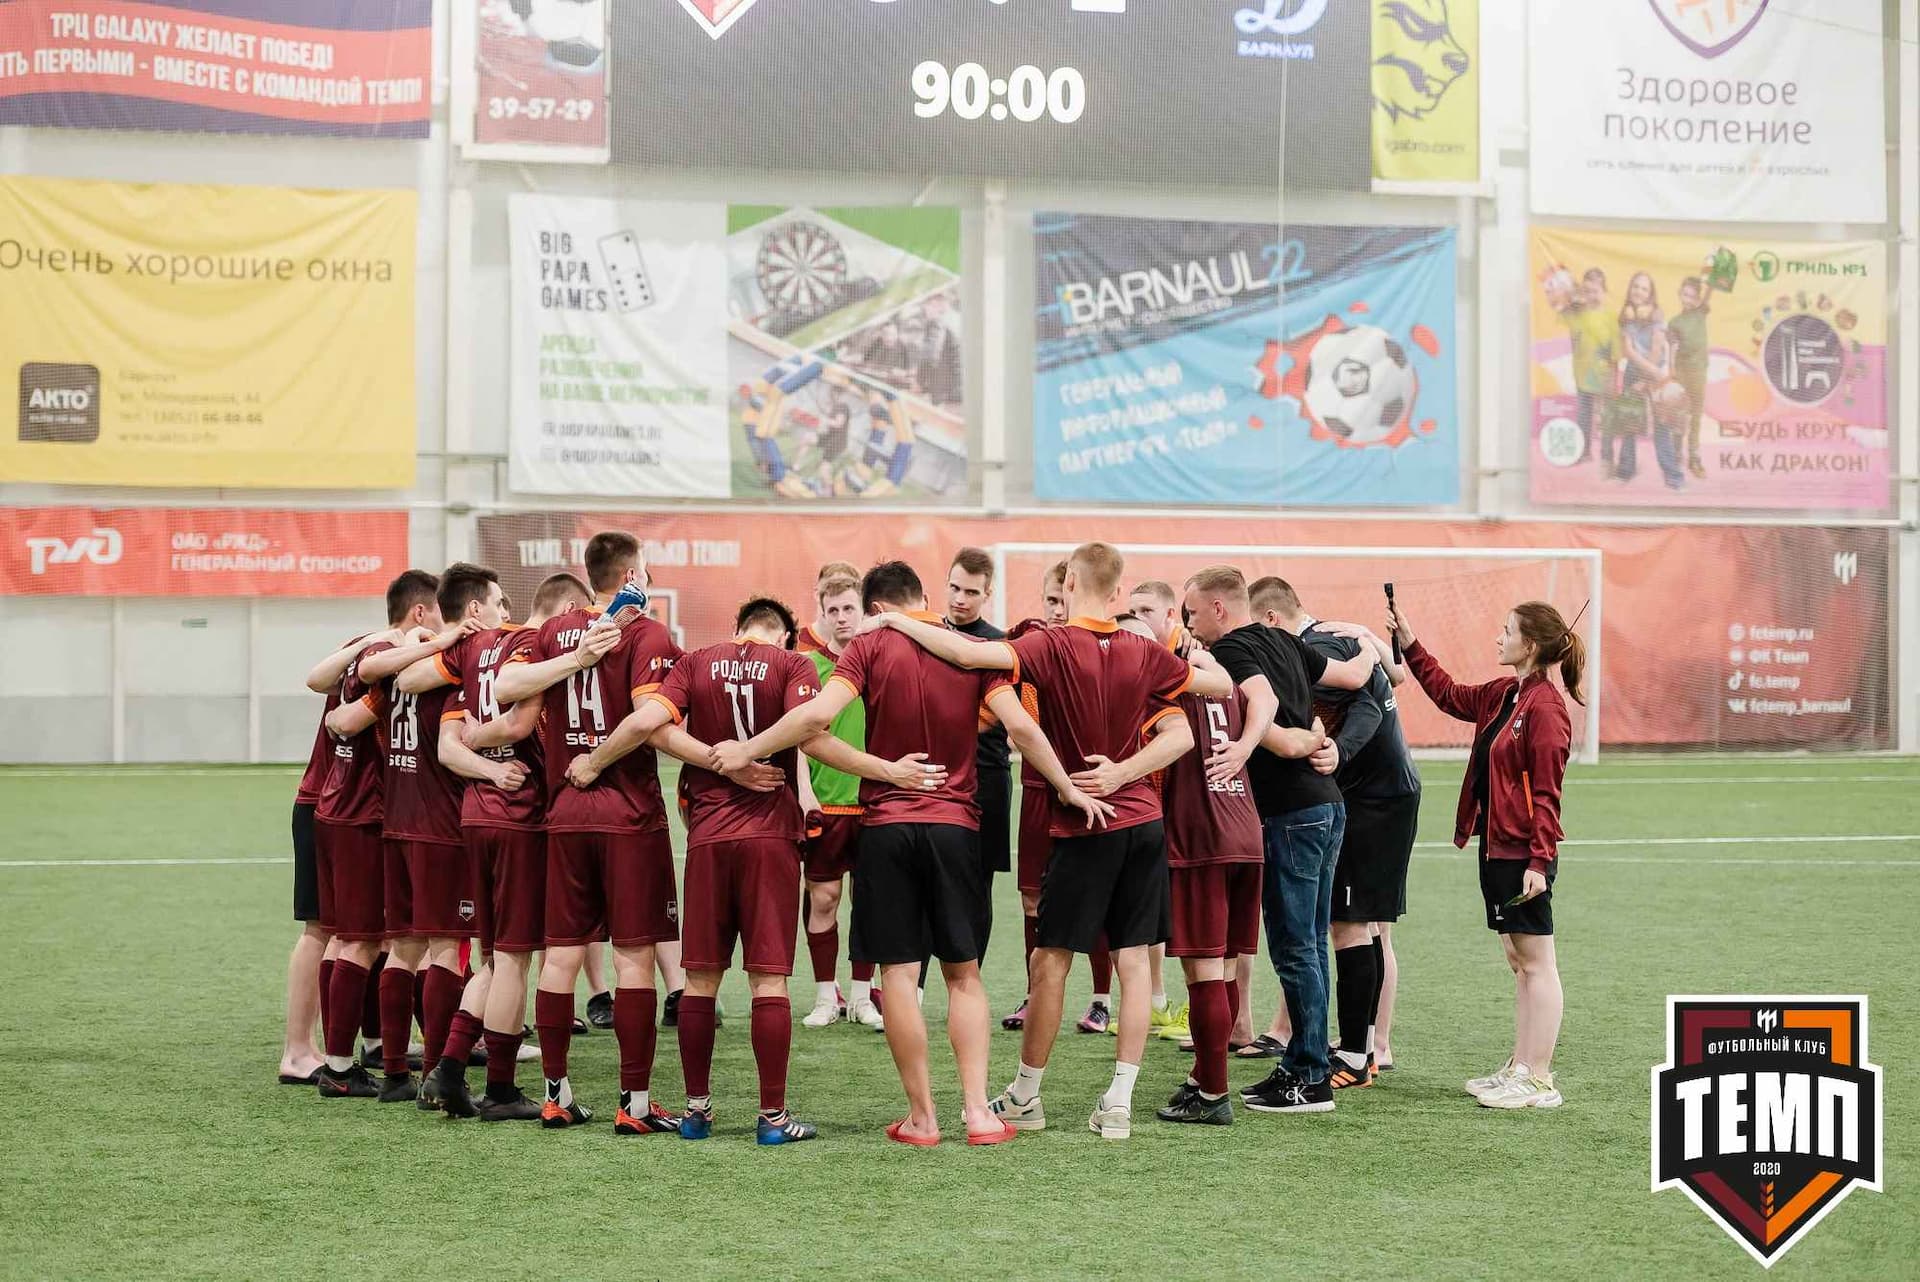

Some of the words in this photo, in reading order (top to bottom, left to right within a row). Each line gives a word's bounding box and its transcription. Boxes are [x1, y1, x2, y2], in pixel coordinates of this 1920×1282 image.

[50, 12, 89, 40] ТРЦ
[94, 14, 171, 45] GALAXY
[175, 26, 256, 60] ЖЕЛАЕТ
[261, 37, 333, 71] ПОБЕД!
[1237, 40, 1314, 60] БАРНАУЛ
[33, 47, 135, 77] ПЕРВЫМИ
[153, 55, 231, 92] ВМЕСТЕ
[235, 67, 249, 92] С
[253, 71, 361, 107] КОМАНДОЙ
[1616, 67, 1798, 107] Здоровое
[911, 60, 1086, 123] 90:00
[488, 97, 594, 120] 39-57-29
[1603, 113, 1812, 145] поколение
[540, 231, 572, 254] BIG
[0, 239, 113, 275] Очень
[127, 252, 294, 284] хорошие
[307, 259, 392, 283] окна
[541, 259, 591, 283] PAPA
[1786, 261, 1838, 276] ГРИЛЬ
[541, 286, 607, 311] GAMES
[1719, 453, 1765, 471] КАК
[171, 532, 208, 550] ОАО
[171, 552, 296, 572] ГЕНЕРАЛЬНЫЙ
[300, 554, 384, 573] СПОНСОР
[566, 666, 606, 731] 14
[1206, 703, 1229, 748] 5
[565, 733, 608, 748] SEUS
[1208, 780, 1244, 792] SEUS
